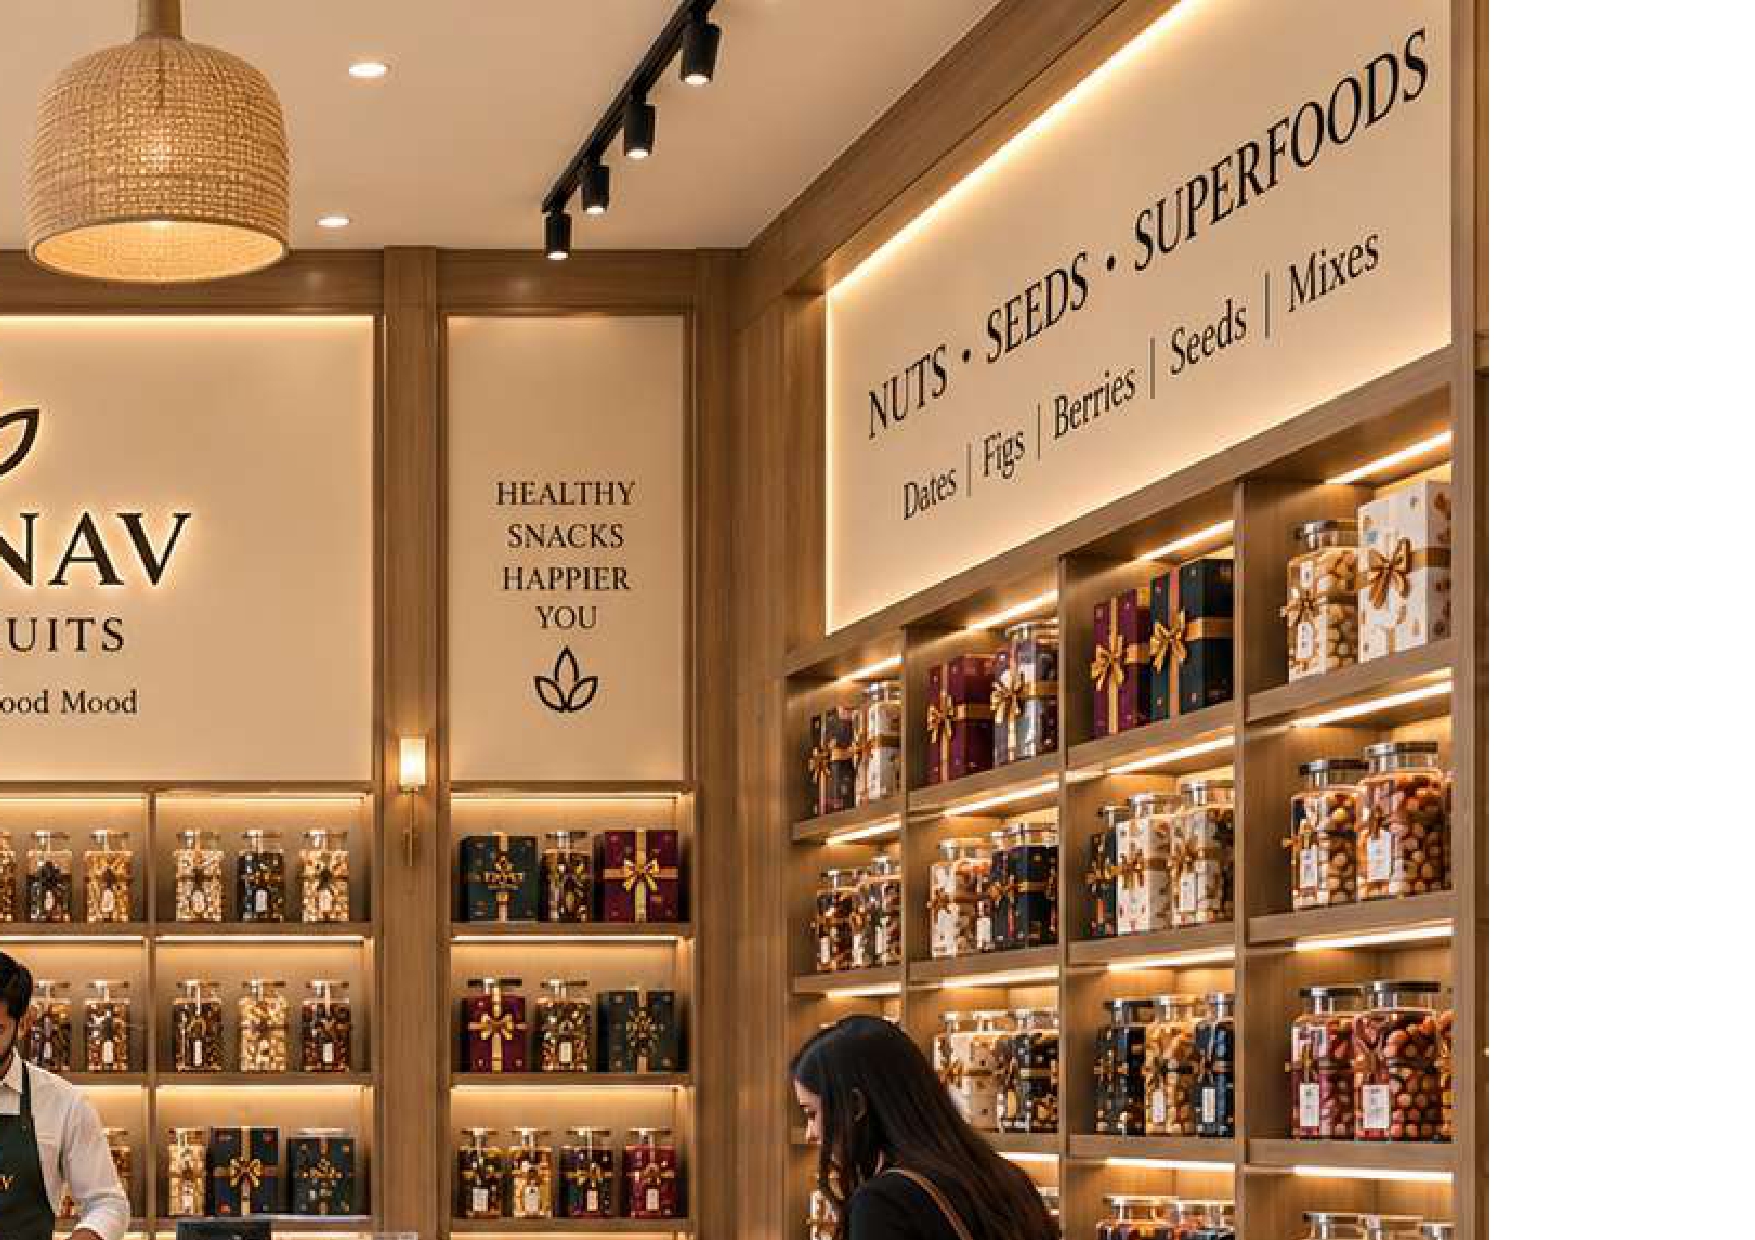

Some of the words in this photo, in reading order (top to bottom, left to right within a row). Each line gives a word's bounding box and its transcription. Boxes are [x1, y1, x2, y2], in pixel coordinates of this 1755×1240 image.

[869, 343, 947, 440] NUTS
[987, 251, 1089, 364] SEEDS
[1134, 28, 1428, 272] SUPERFOODS
[904, 468, 957, 521] Dates
[983, 431, 1026, 479] Figs
[1053, 367, 1135, 440] Berries
[1170, 297, 1248, 376] Seeds
[1288, 233, 1380, 313] Mixes
[496, 480, 636, 506] HEALTHY
[507, 523, 625, 549] SNACKS
[502, 566, 631, 591] HAPPIER
[534, 605, 597, 629] YOU
[60, 688, 139, 715] Mood
